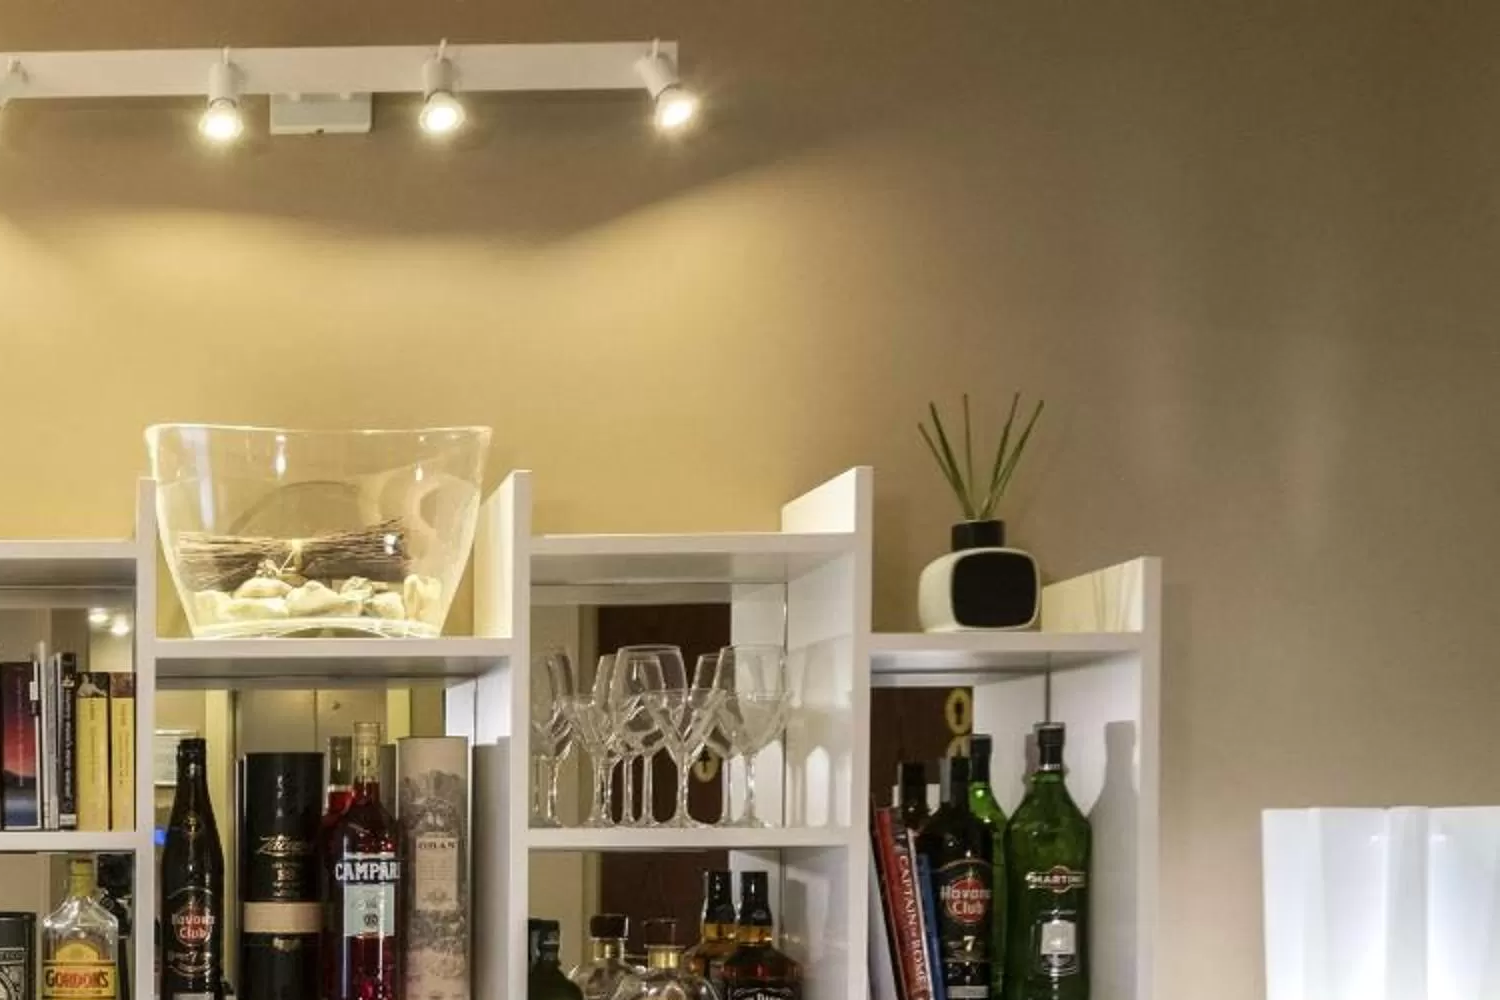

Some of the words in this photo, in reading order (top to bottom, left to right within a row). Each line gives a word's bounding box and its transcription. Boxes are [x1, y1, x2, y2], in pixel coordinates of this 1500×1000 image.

[335, 861, 401, 881] CAMPARI
[899, 855, 916, 925] CAPTAIN
[940, 885, 992, 901] Havana
[952, 900, 985, 915] Club
[180, 926, 207, 939] Club
[963, 935, 976, 952] 7
